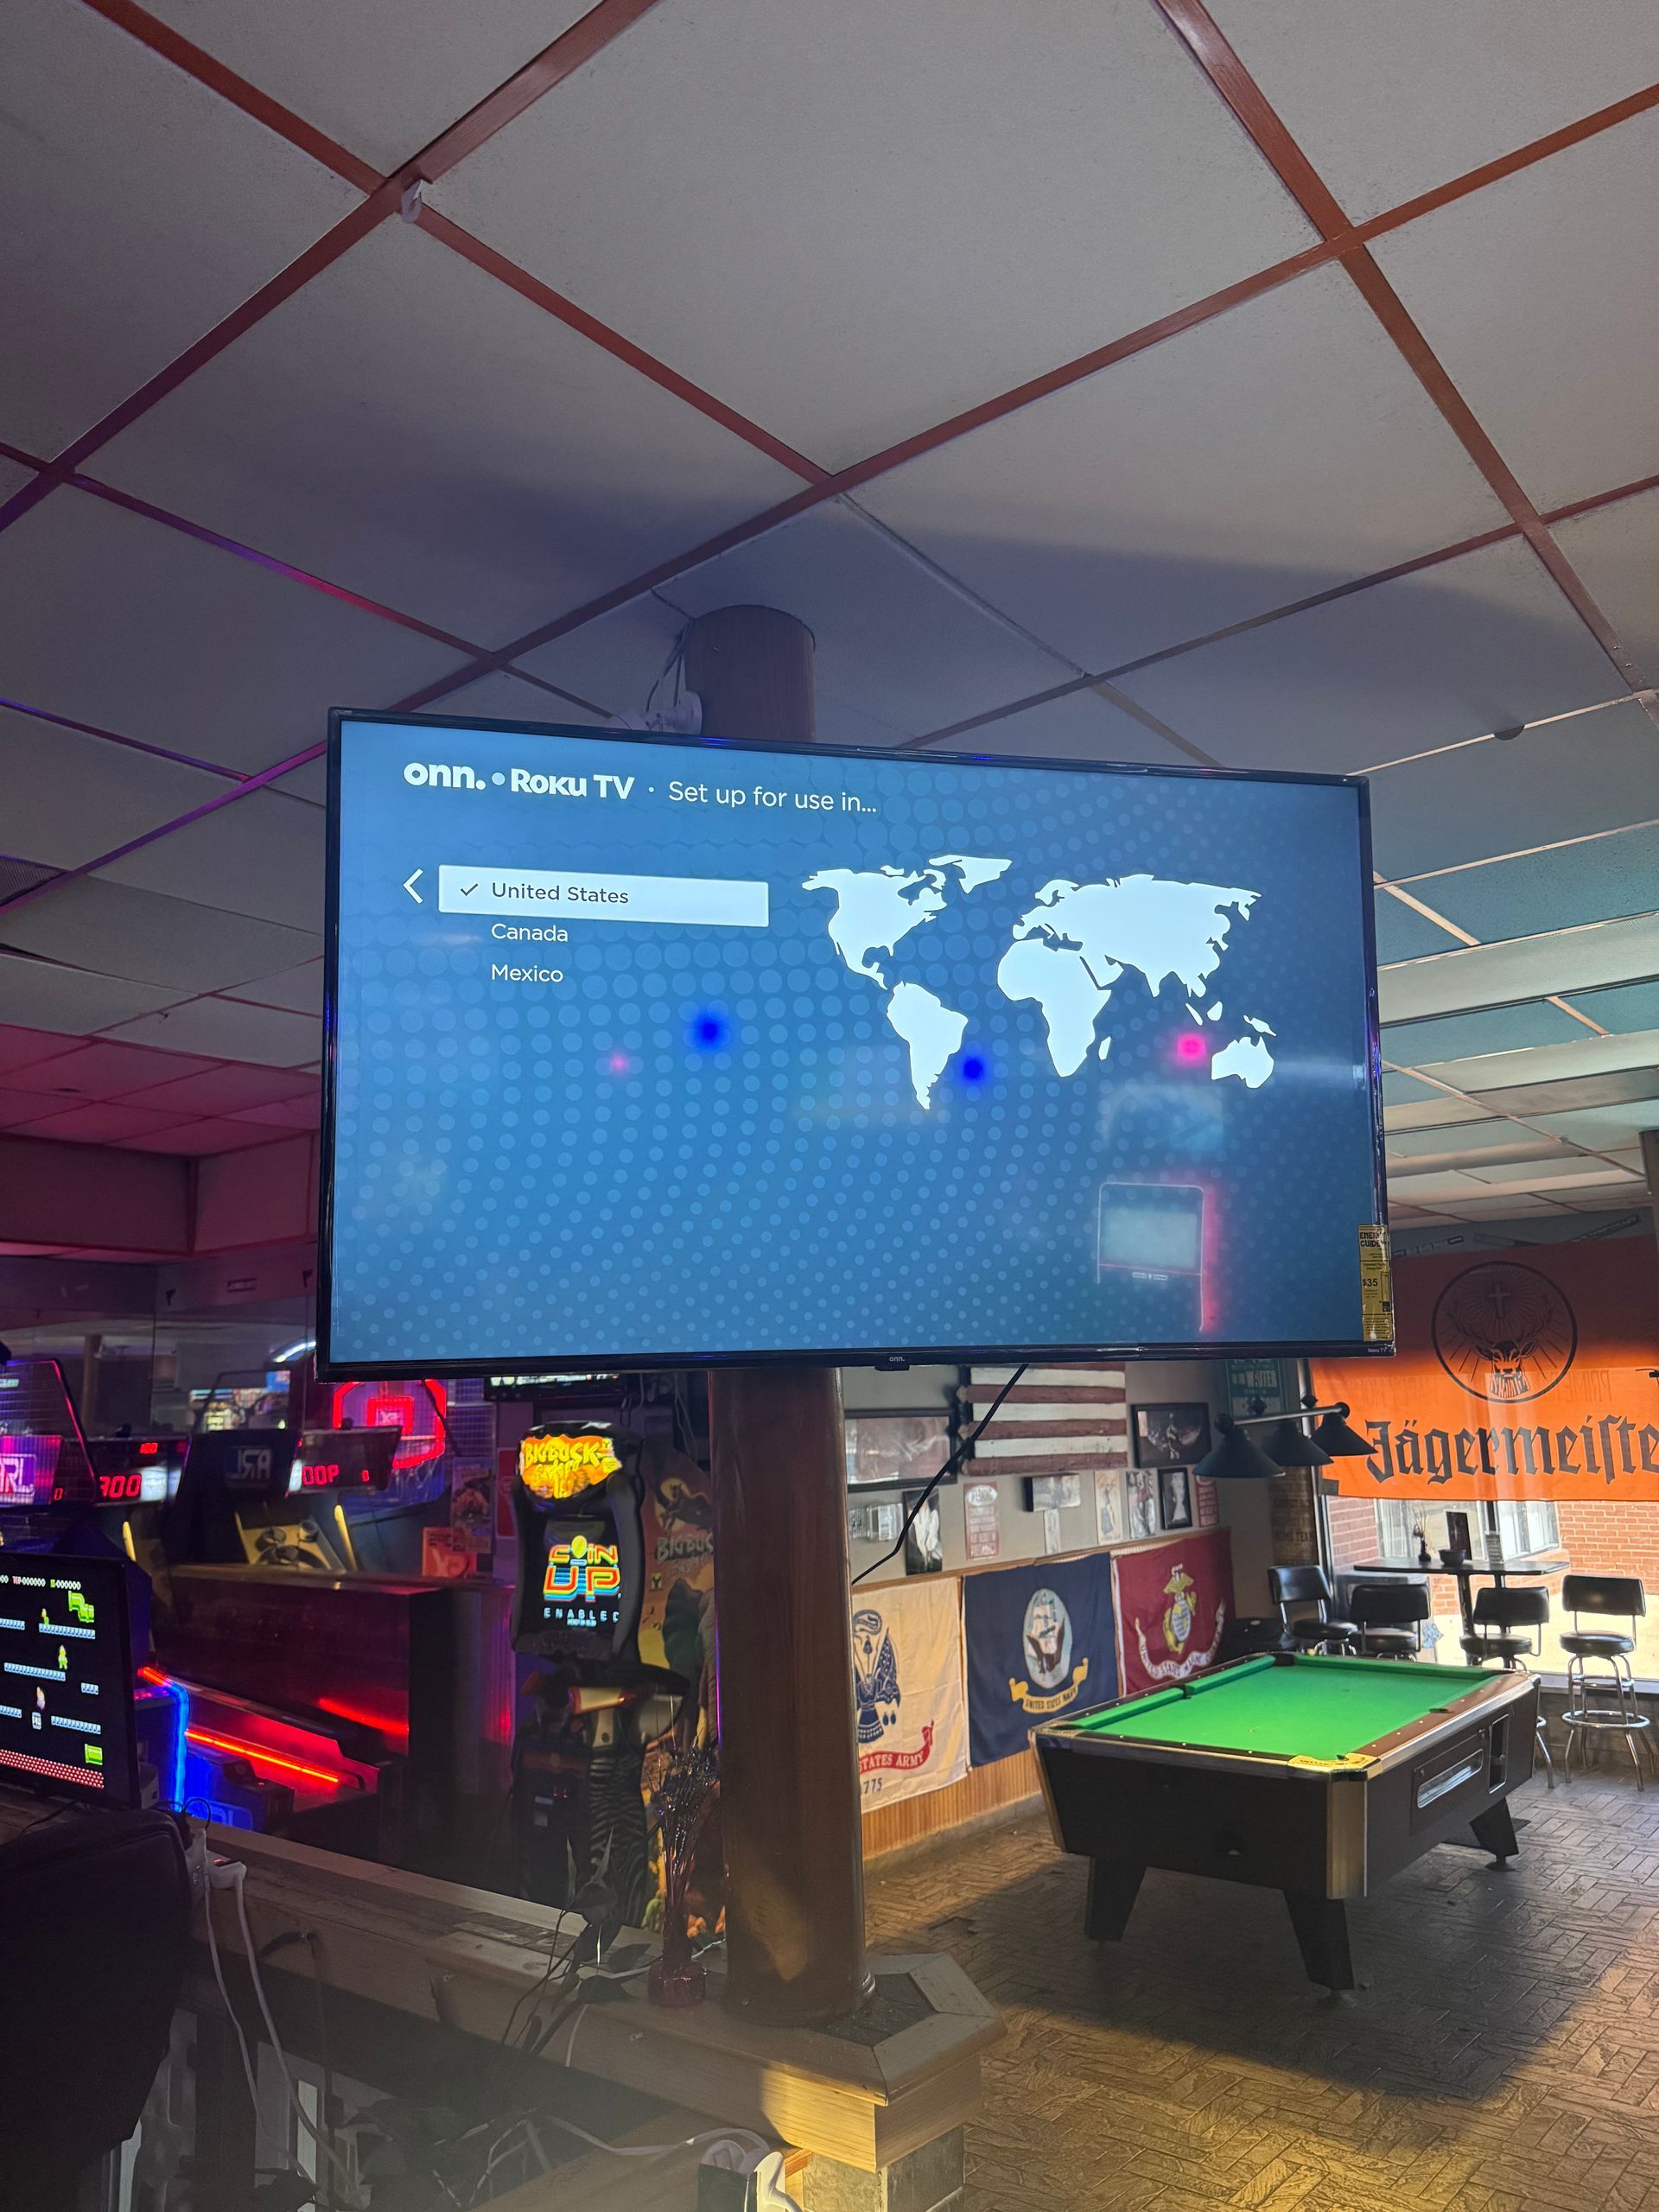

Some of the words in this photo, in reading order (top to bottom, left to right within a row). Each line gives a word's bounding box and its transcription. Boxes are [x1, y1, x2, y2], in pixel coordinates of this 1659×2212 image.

[404, 762, 486, 790] onn.
[512, 768, 587, 797] Roku
[594, 774, 635, 799] TV
[669, 781, 708, 803] Set
[716, 787, 746, 807] up
[753, 785, 787, 807] for
[795, 793, 834, 810] use
[842, 791, 876, 812] in...
[492, 882, 560, 900] United
[568, 887, 629, 904] States
[491, 923, 569, 942] Canada
[491, 963, 563, 982] Mexico
[1363, 1278, 1378, 1287] $35
[543, 1565, 621, 1602] UP
[1026, 1699, 1045, 1710] UNITED
[895, 1750, 924, 1768] ARMY
